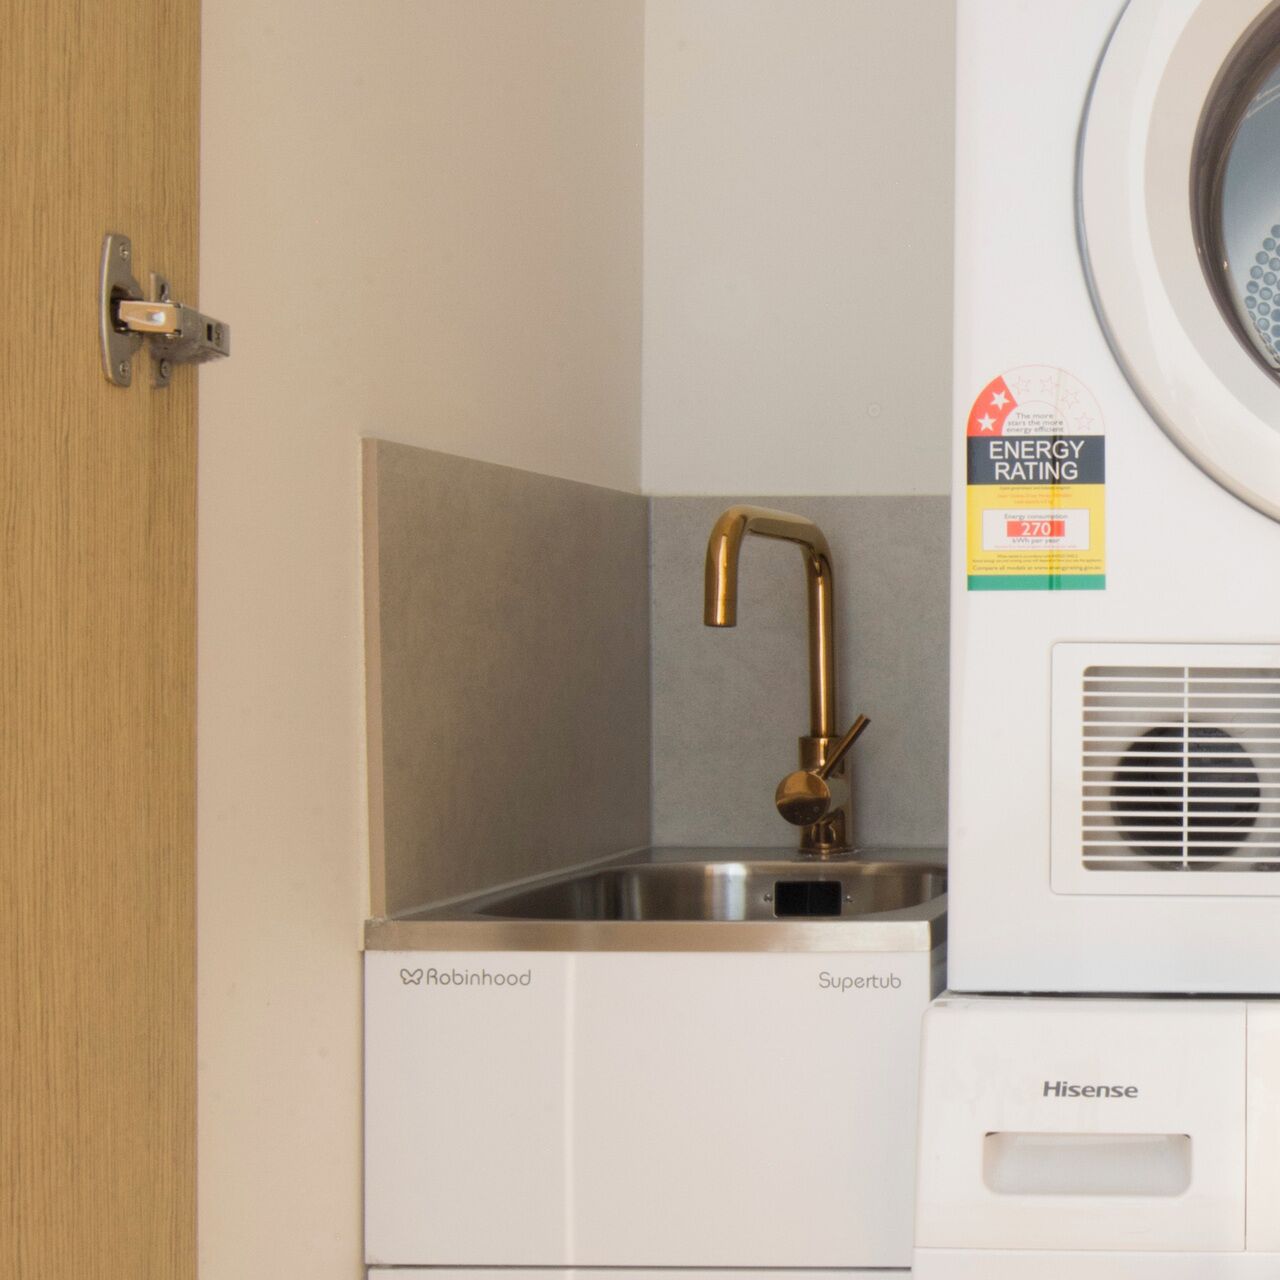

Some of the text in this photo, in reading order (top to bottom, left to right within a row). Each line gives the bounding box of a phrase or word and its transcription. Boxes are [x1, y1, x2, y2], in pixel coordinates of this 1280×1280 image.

[989, 440, 1085, 460] ENERGY
[995, 462, 1079, 480] RATING
[1021, 522, 1051, 536] 270
[426, 968, 532, 986] Robinhood
[818, 971, 902, 992] Supertub
[1043, 1081, 1139, 1098] Hisense
